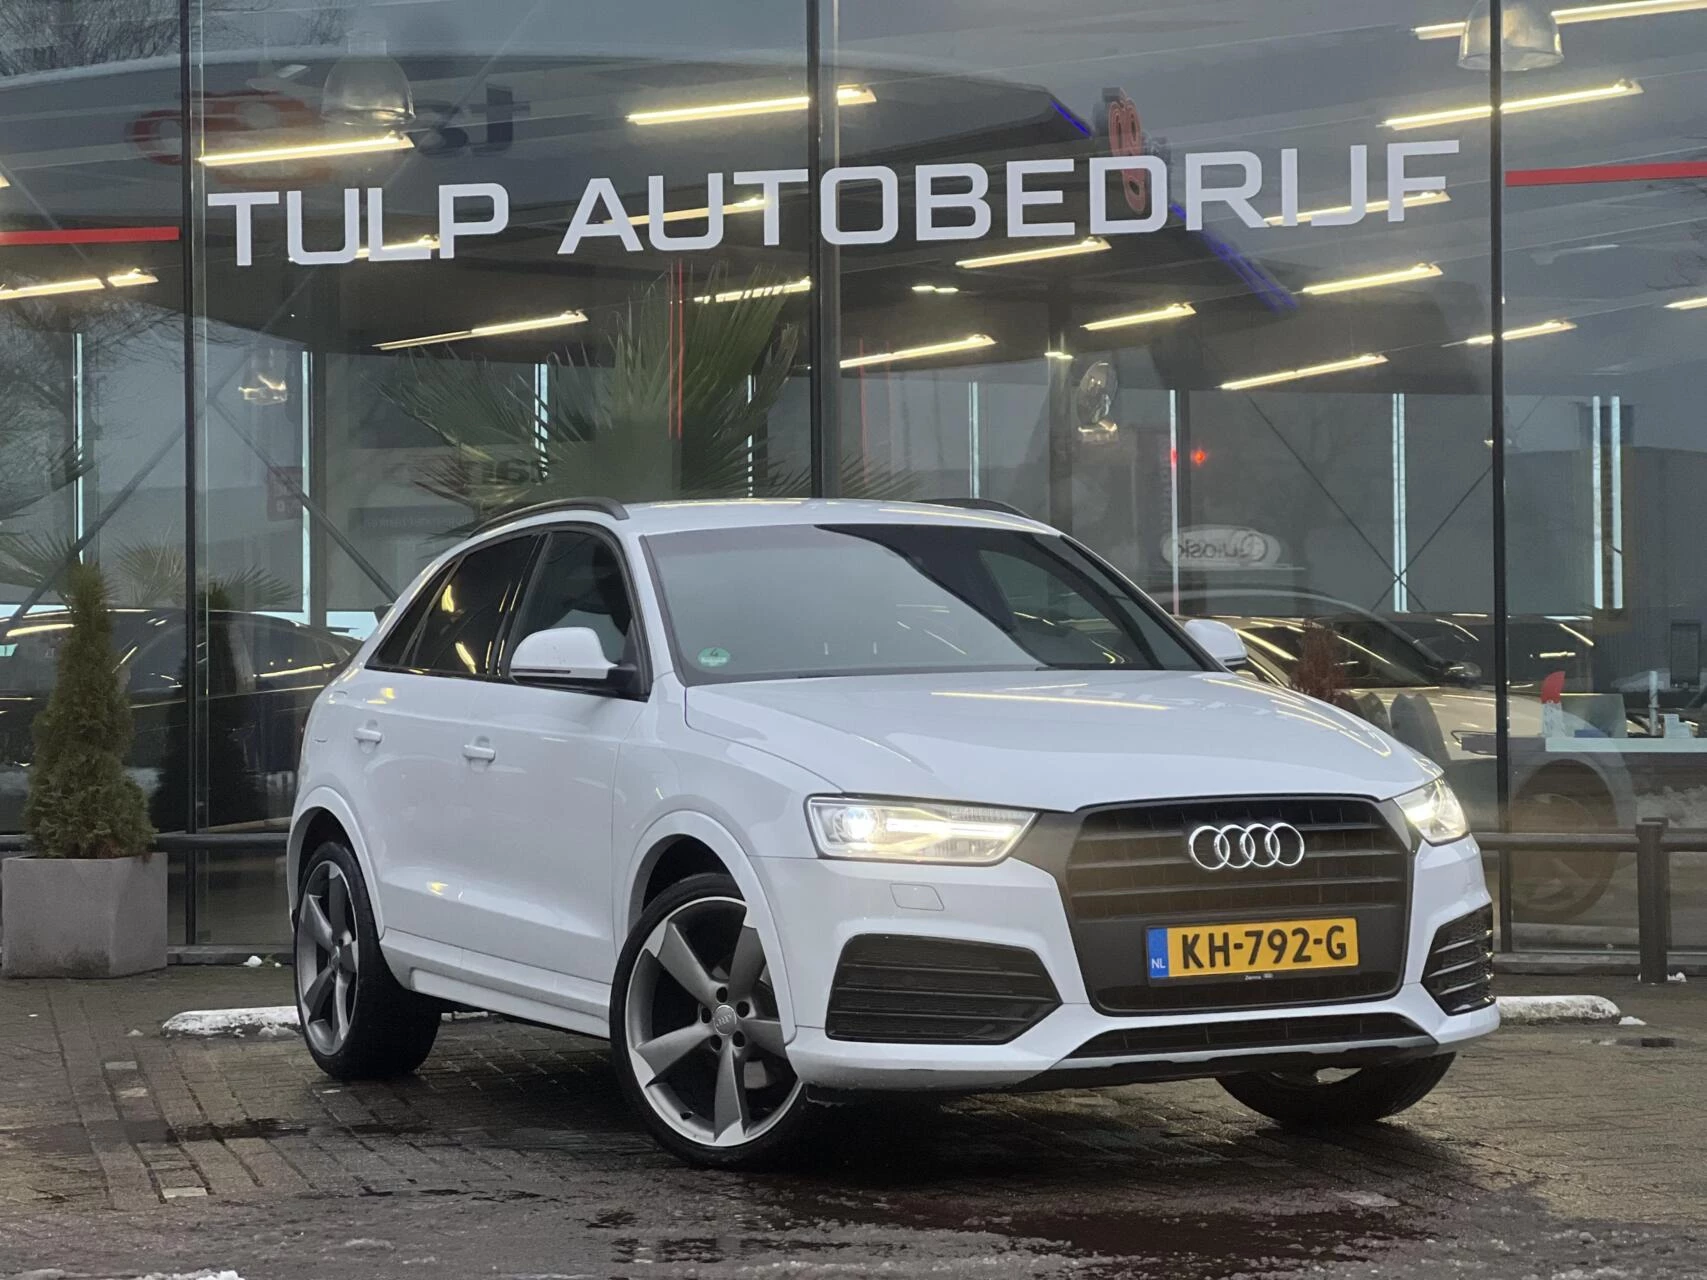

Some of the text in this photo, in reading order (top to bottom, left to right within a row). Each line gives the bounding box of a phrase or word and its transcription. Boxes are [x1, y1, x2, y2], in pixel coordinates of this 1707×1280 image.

[207, 139, 1460, 266] TULP AUTOBEDRIJF
[1151, 958, 1166, 969] NL
[1181, 925, 1347, 969] KH-792-G
